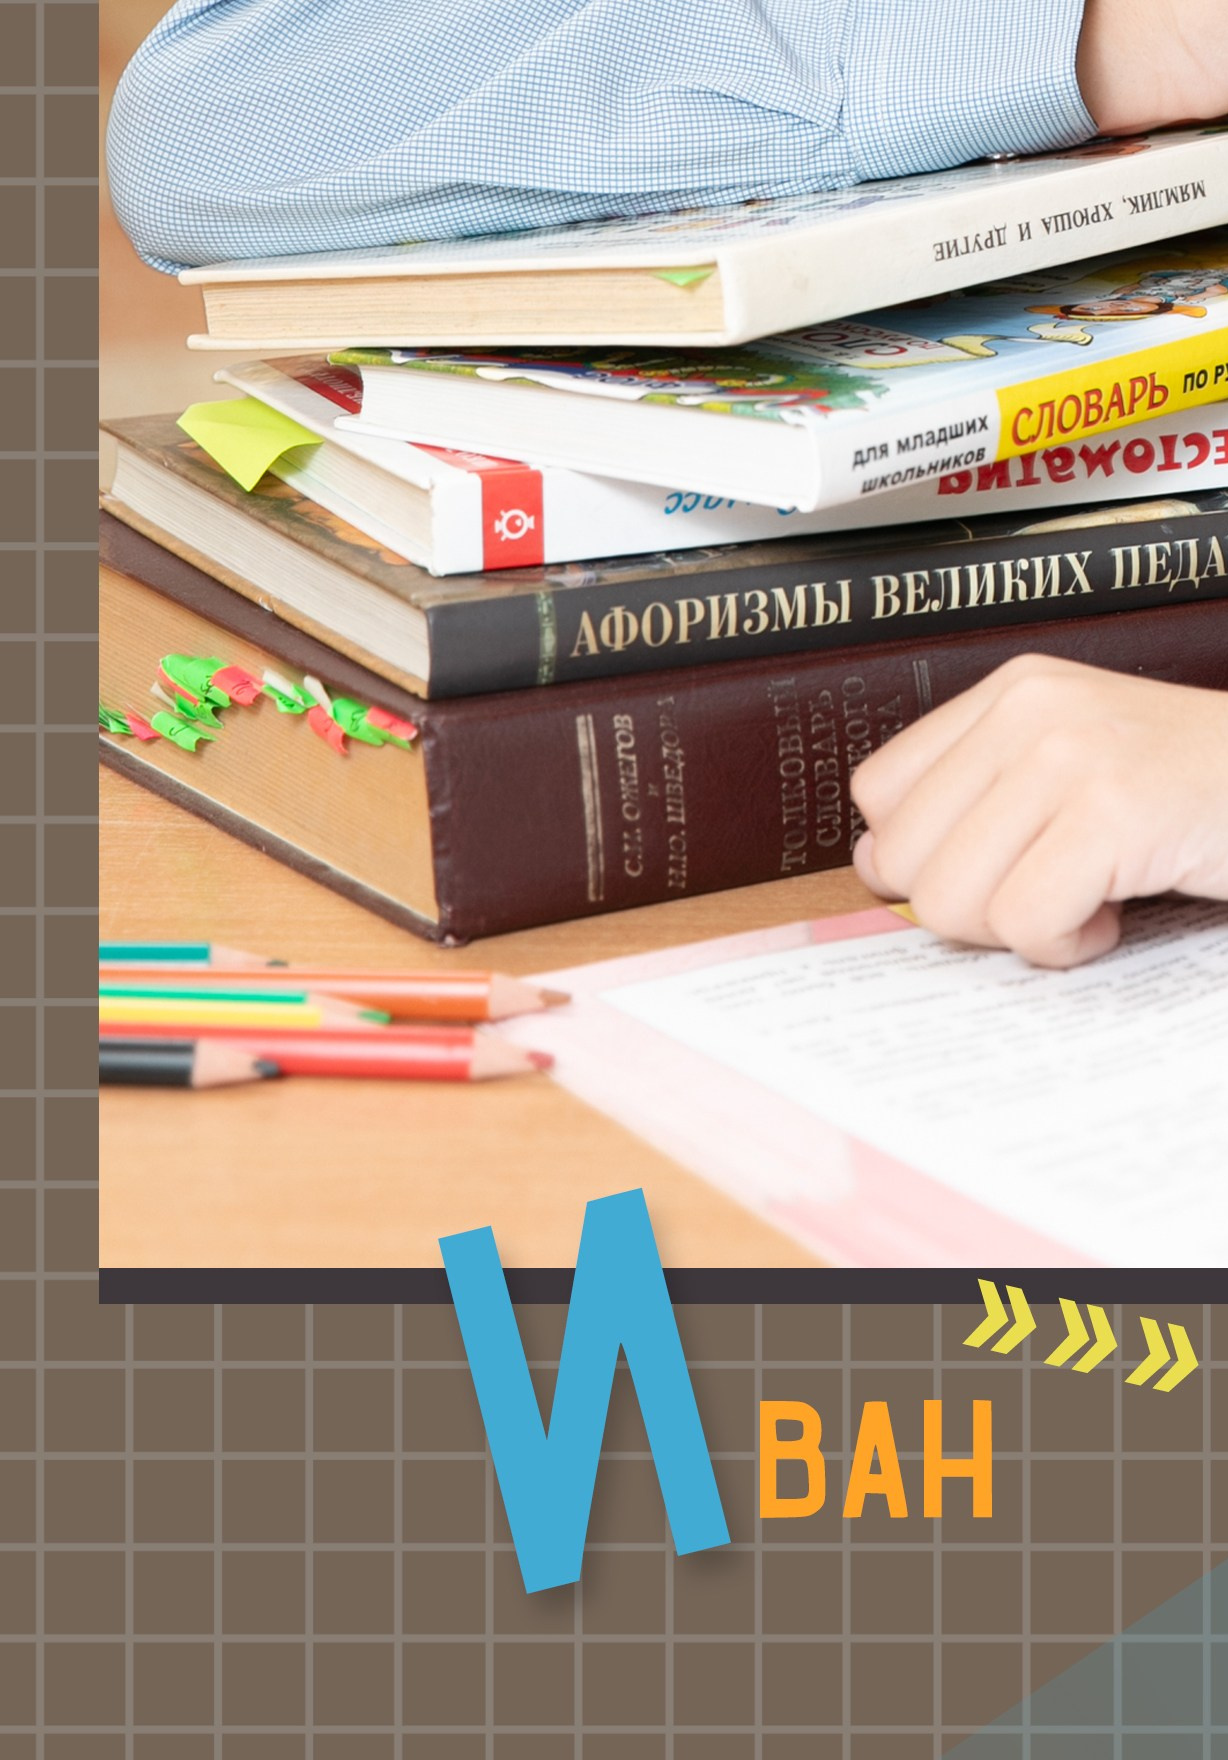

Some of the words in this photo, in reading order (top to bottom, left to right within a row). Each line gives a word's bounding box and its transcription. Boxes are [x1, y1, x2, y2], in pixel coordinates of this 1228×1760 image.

[1041, 201, 1114, 236] ХРЮША
[1122, 179, 1207, 216] МЯМЛИК,
[933, 222, 1007, 262] ДРУГИЕ
[1018, 221, 1033, 241] И
[1011, 371, 1170, 447] СЛОВАРЬ
[1182, 369, 1210, 394] ПО
[852, 441, 890, 472] для
[896, 414, 990, 456] младших
[860, 446, 987, 494] школьников
[570, 578, 853, 658] АФОРИЗМЫ
[871, 550, 1093, 620] ВЕЛИКИХ
[612, 713, 640, 822] ОЖЕГОВ
[767, 676, 807, 873] ТОЛКОВЫЙ
[810, 690, 842, 848] СЛОВАРЬ
